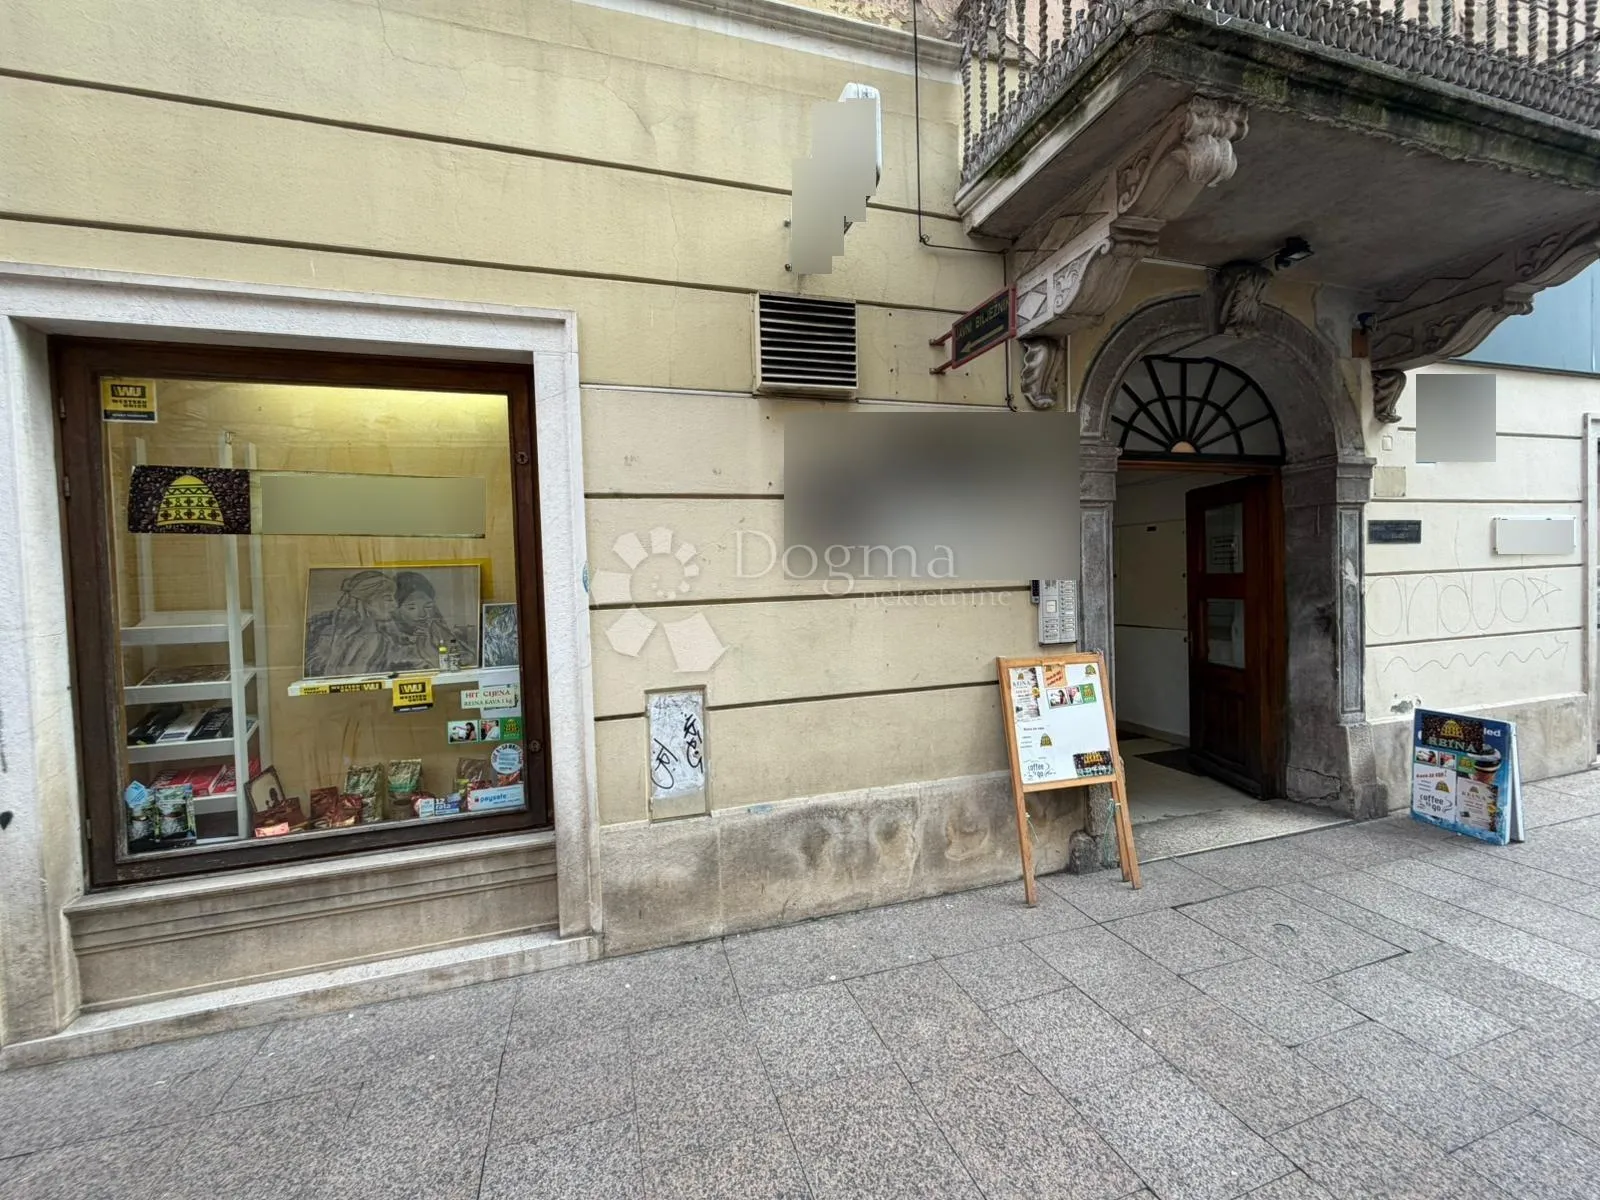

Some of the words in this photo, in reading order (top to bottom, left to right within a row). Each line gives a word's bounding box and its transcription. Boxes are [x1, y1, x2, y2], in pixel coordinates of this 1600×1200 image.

[465, 691, 478, 699] HIT
[1428, 736, 1477, 753] REINA
[1420, 794, 1444, 805] coffee
